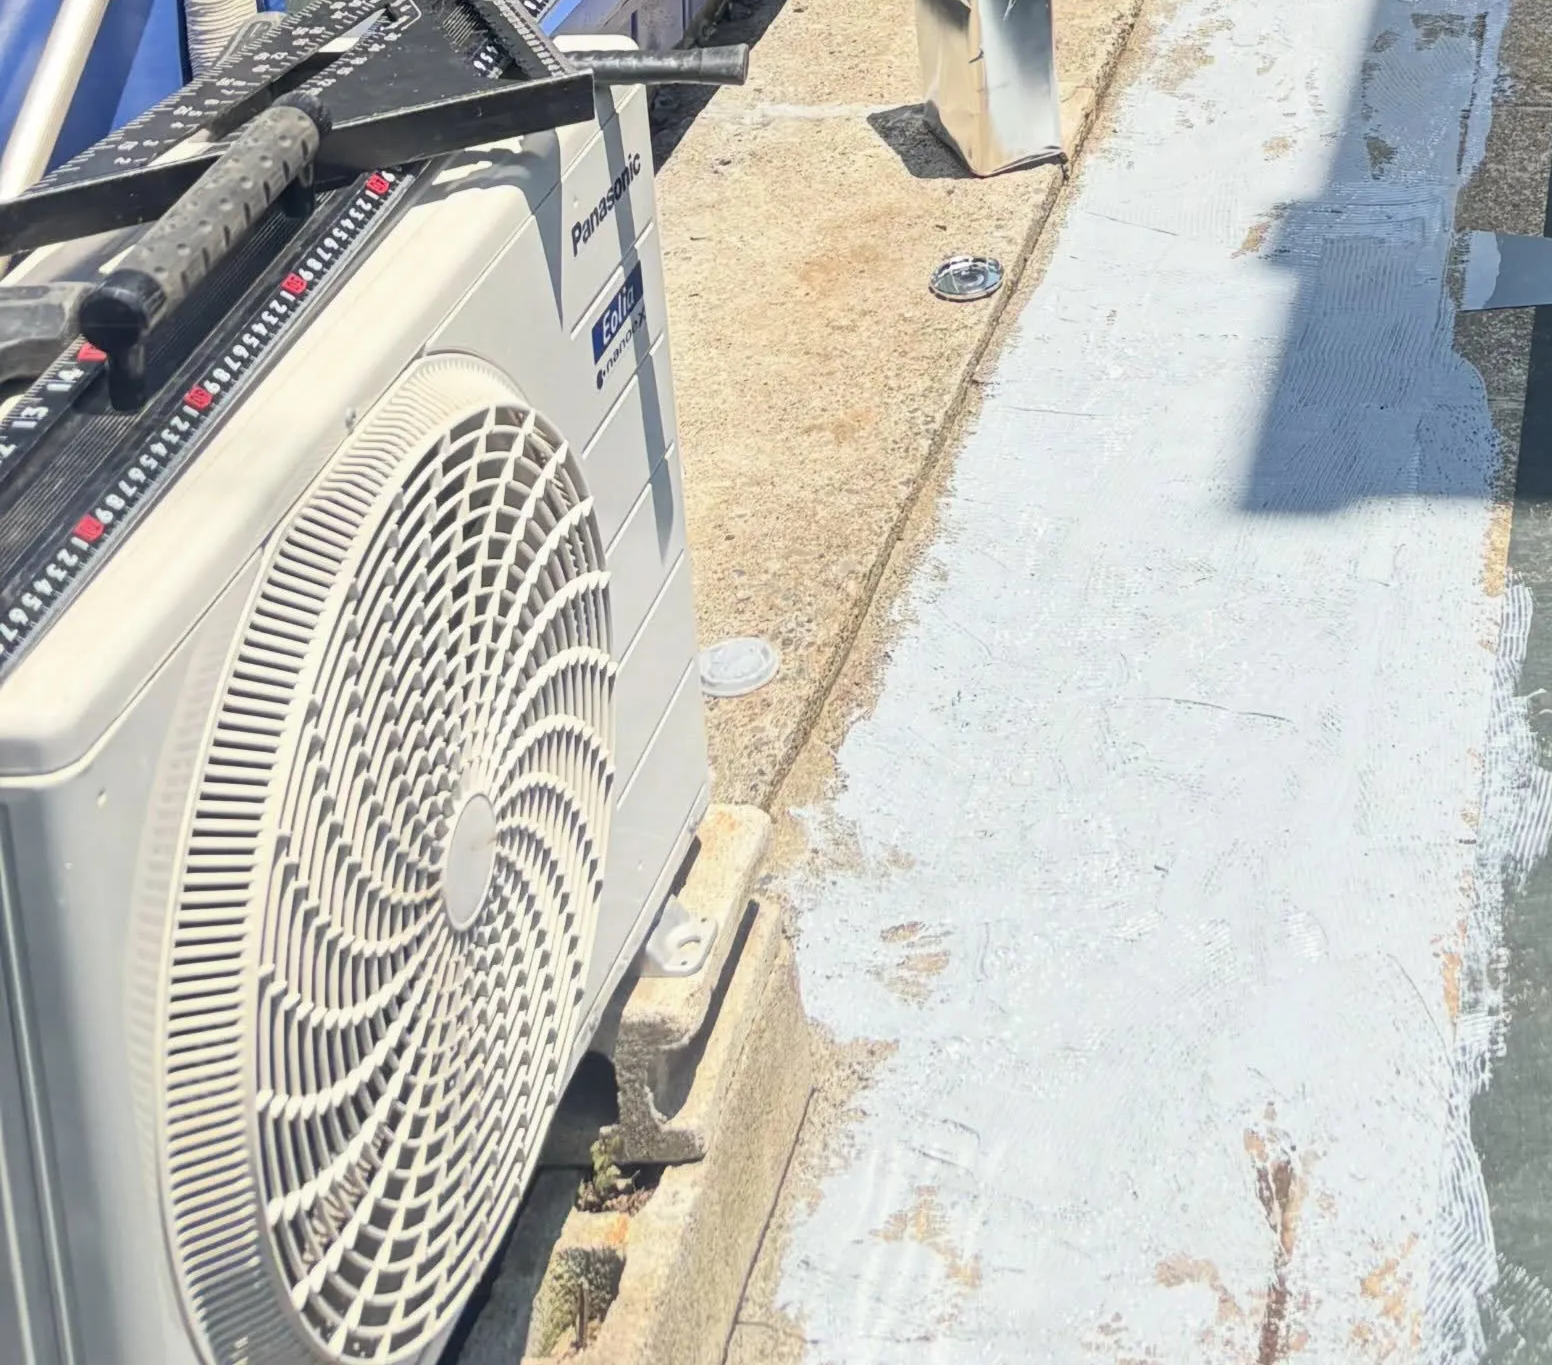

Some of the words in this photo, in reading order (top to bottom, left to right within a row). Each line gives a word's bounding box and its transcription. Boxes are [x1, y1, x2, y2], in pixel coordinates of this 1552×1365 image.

[571, 153, 641, 257] Panasonic
[602, 285, 635, 345] Eolia
[47, 368, 85, 391] 14
[12, 406, 49, 428] 13
